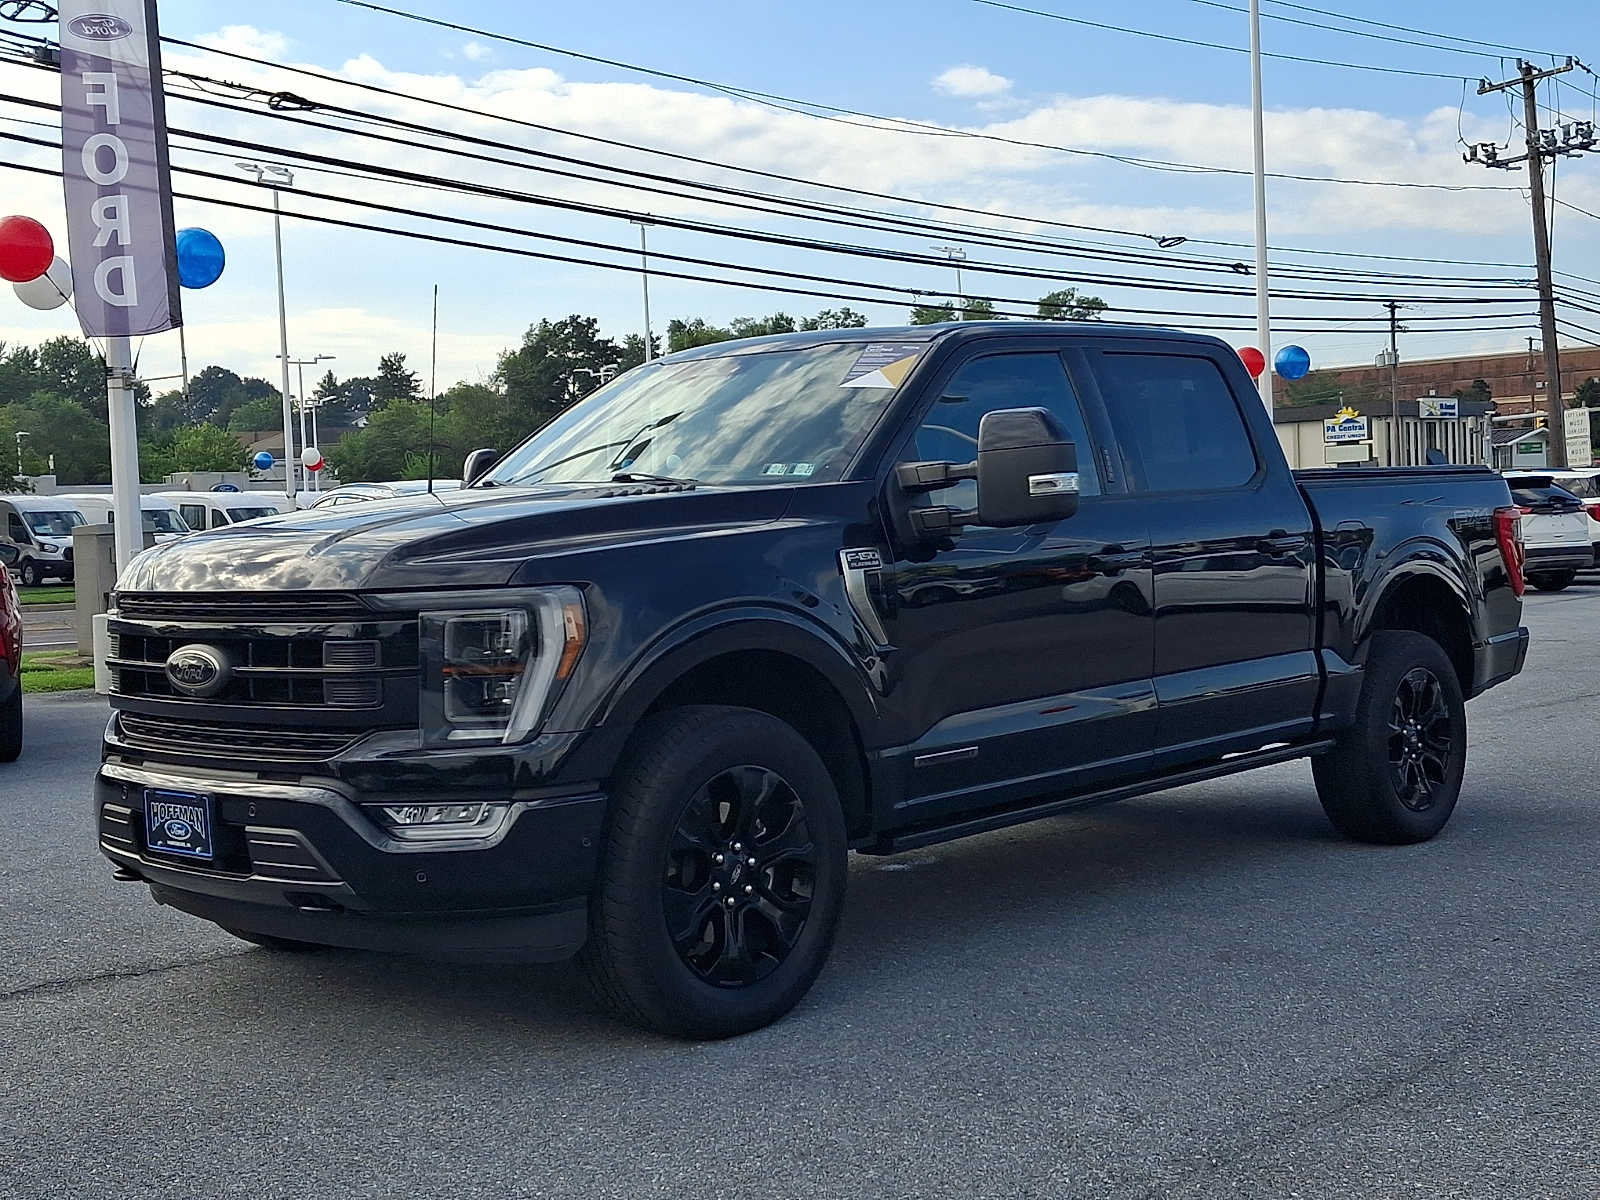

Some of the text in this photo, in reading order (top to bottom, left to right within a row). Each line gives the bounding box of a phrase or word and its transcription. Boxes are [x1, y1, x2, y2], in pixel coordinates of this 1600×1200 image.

[1326, 423, 1365, 433] PA Central
[847, 552, 878, 562] F-150
[175, 657, 205, 680] Ford
[150, 802, 206, 839] HOFFMAN
